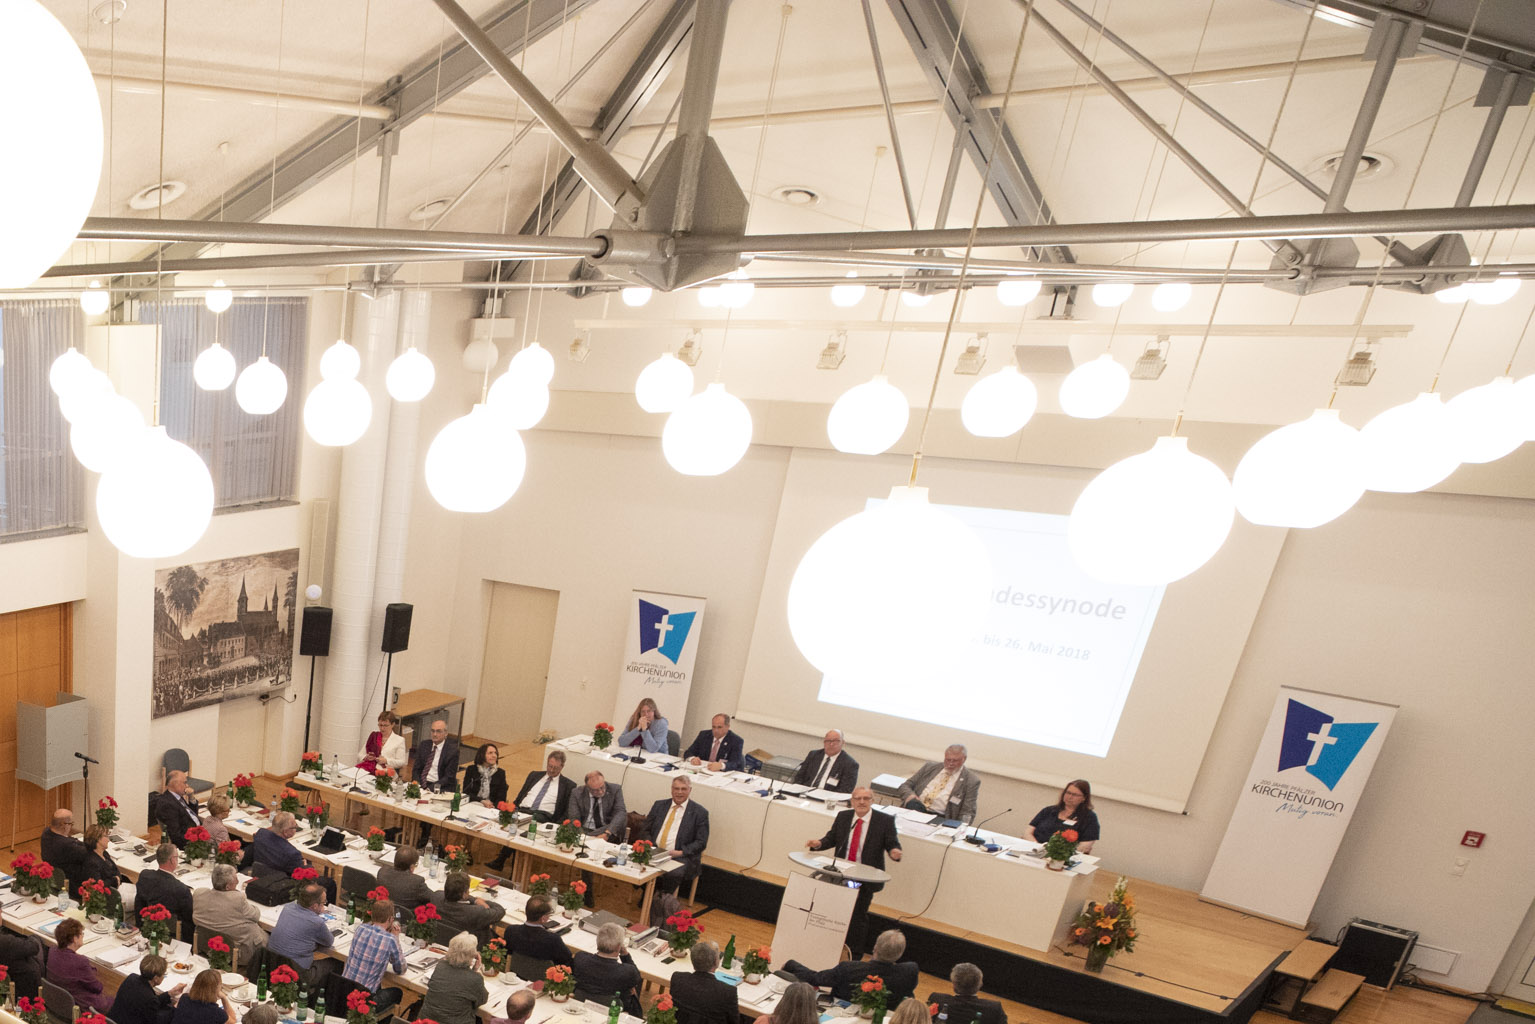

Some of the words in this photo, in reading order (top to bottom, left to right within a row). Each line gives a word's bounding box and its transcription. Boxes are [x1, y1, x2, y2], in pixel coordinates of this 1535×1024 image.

[983, 634, 1001, 648] bis
[1028, 641, 1053, 654] Mai
[1056, 645, 1091, 661] 2018
